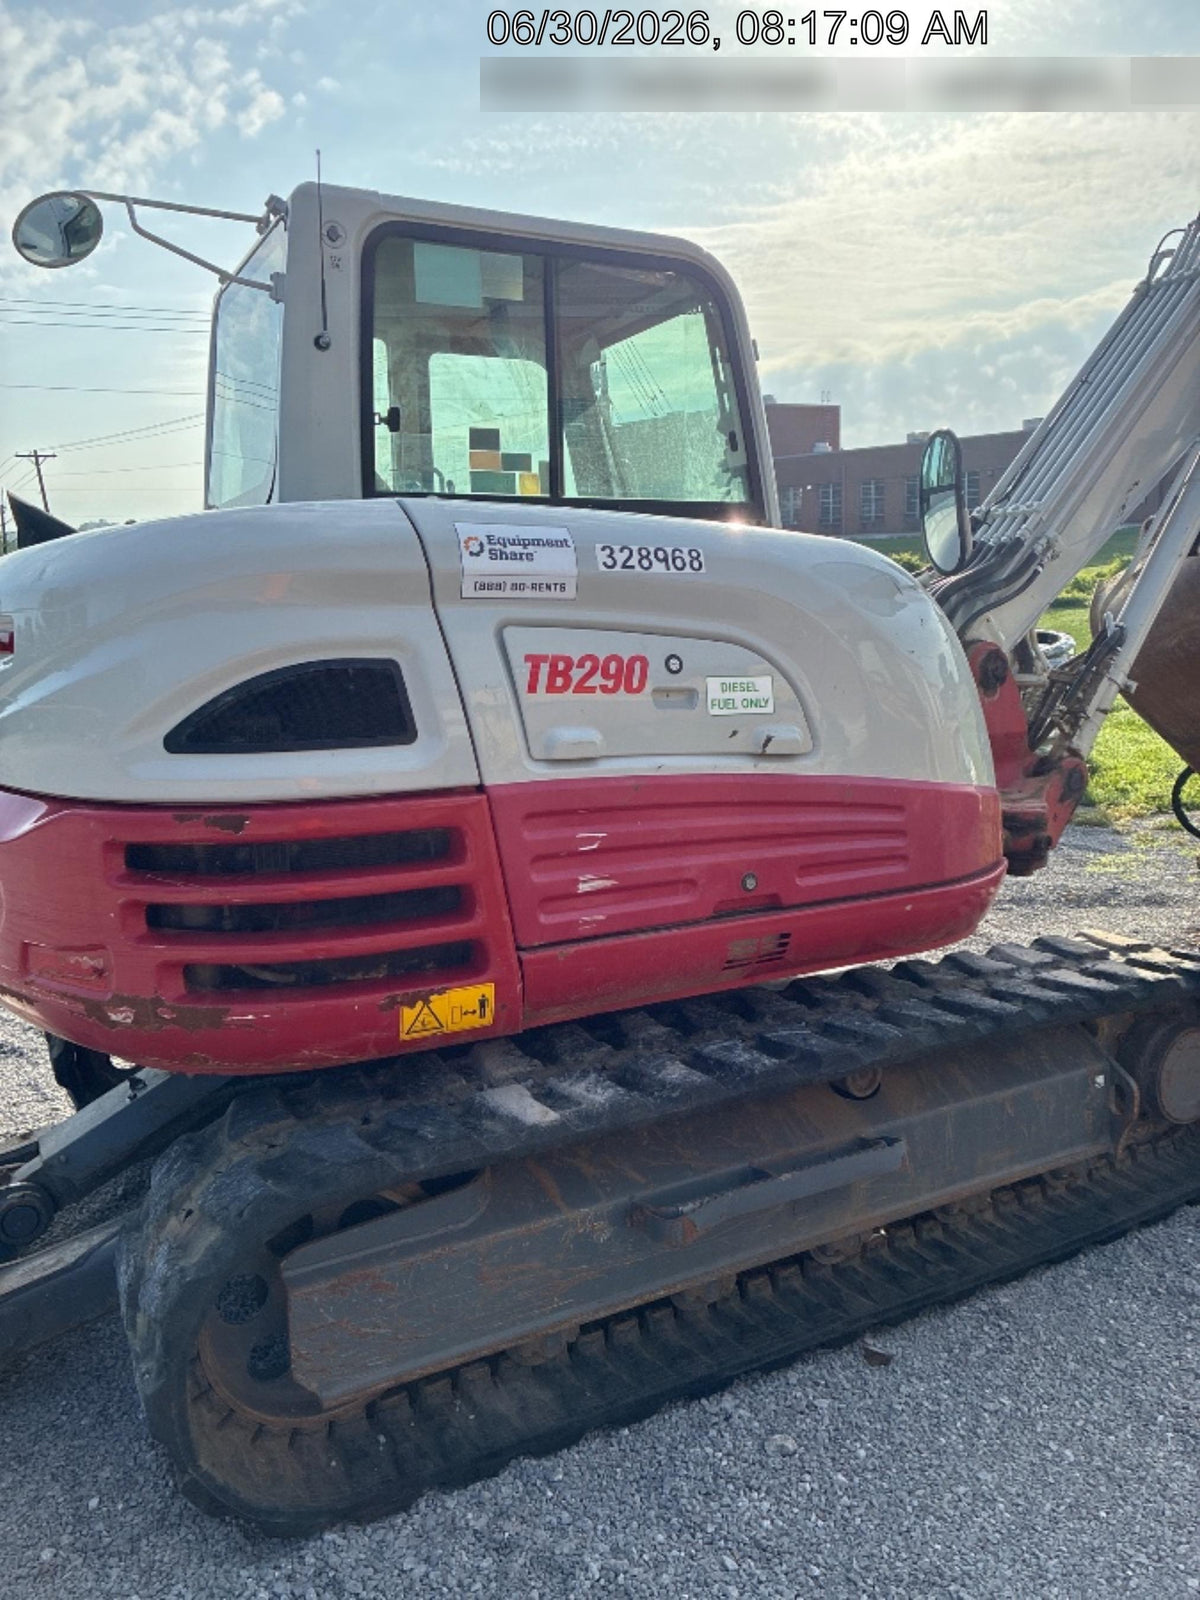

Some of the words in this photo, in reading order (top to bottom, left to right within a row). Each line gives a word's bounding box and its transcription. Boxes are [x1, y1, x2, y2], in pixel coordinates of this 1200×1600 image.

[485, 534, 571, 550] Equipment
[488, 548, 535, 562] Share
[600, 545, 703, 571] 328968
[524, 654, 649, 694] TB290
[720, 682, 760, 693] DIESEL
[711, 698, 738, 710] FUEL
[741, 697, 769, 709] ONLY
